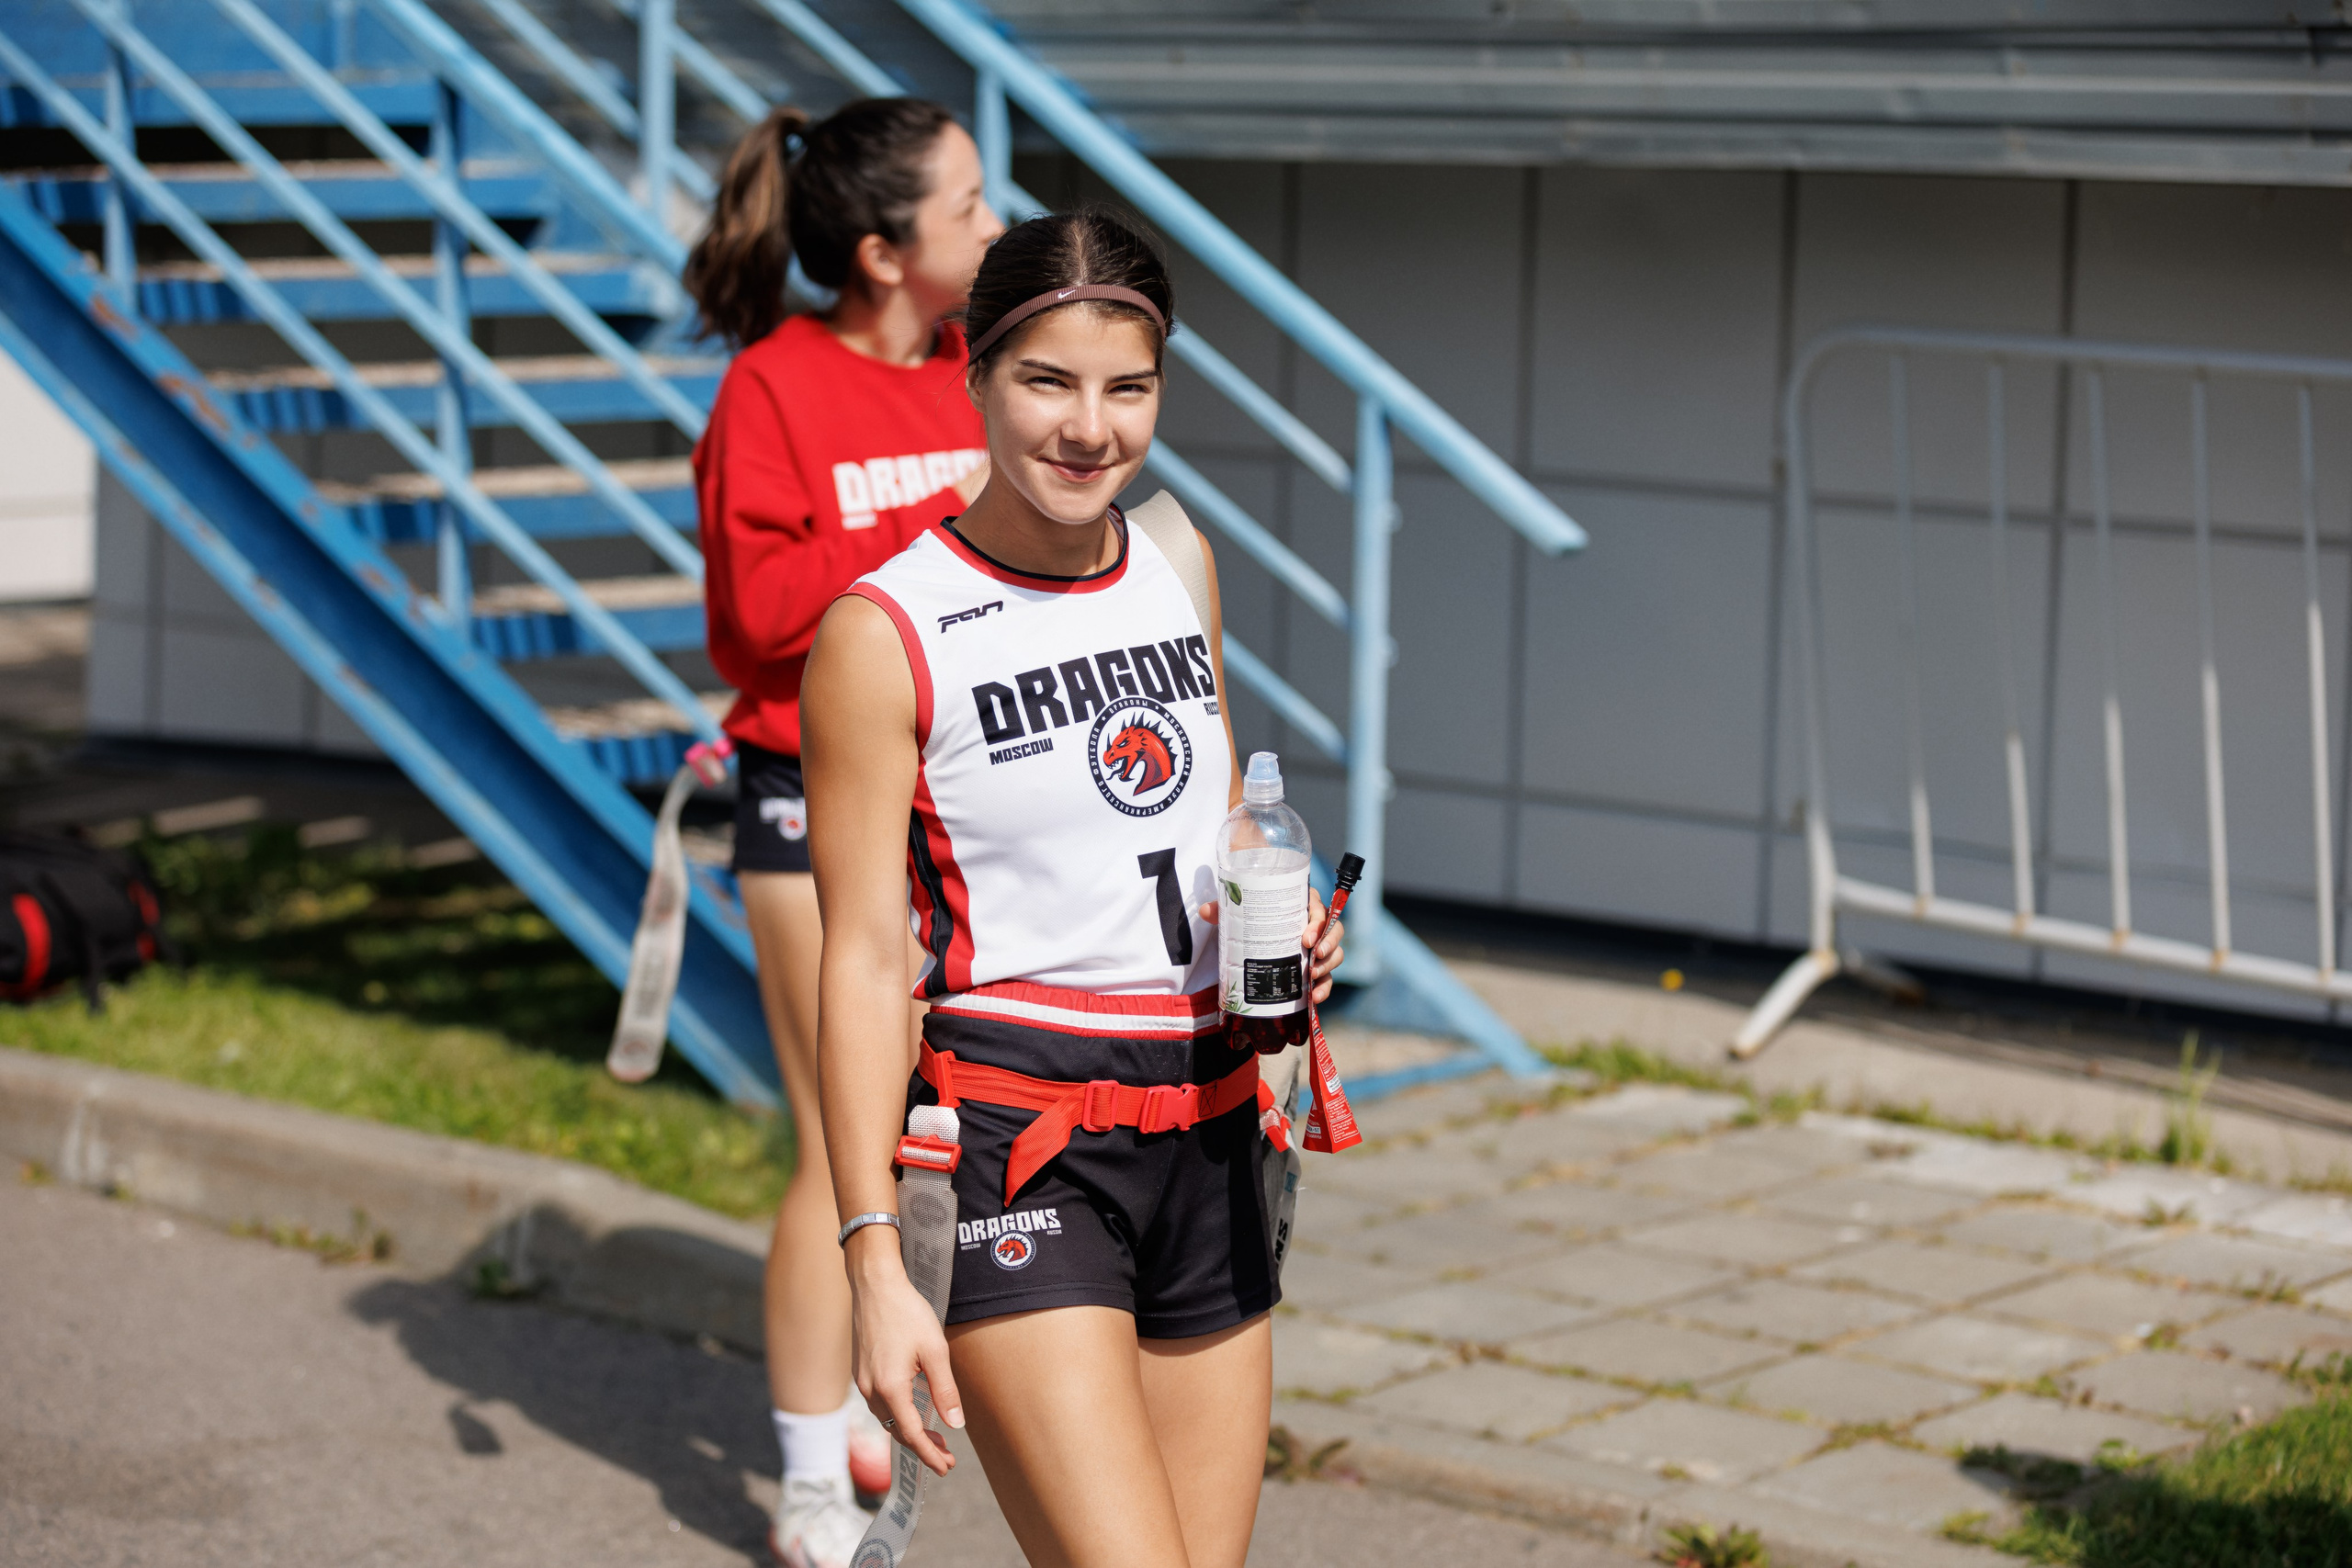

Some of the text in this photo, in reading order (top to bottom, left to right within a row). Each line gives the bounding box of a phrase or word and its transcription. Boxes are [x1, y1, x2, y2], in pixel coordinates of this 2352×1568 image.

[971, 633, 1216, 746] DRAGONS
[989, 738, 1055, 765] MOSCOW
[957, 1208, 1061, 1244] DRAGONS
